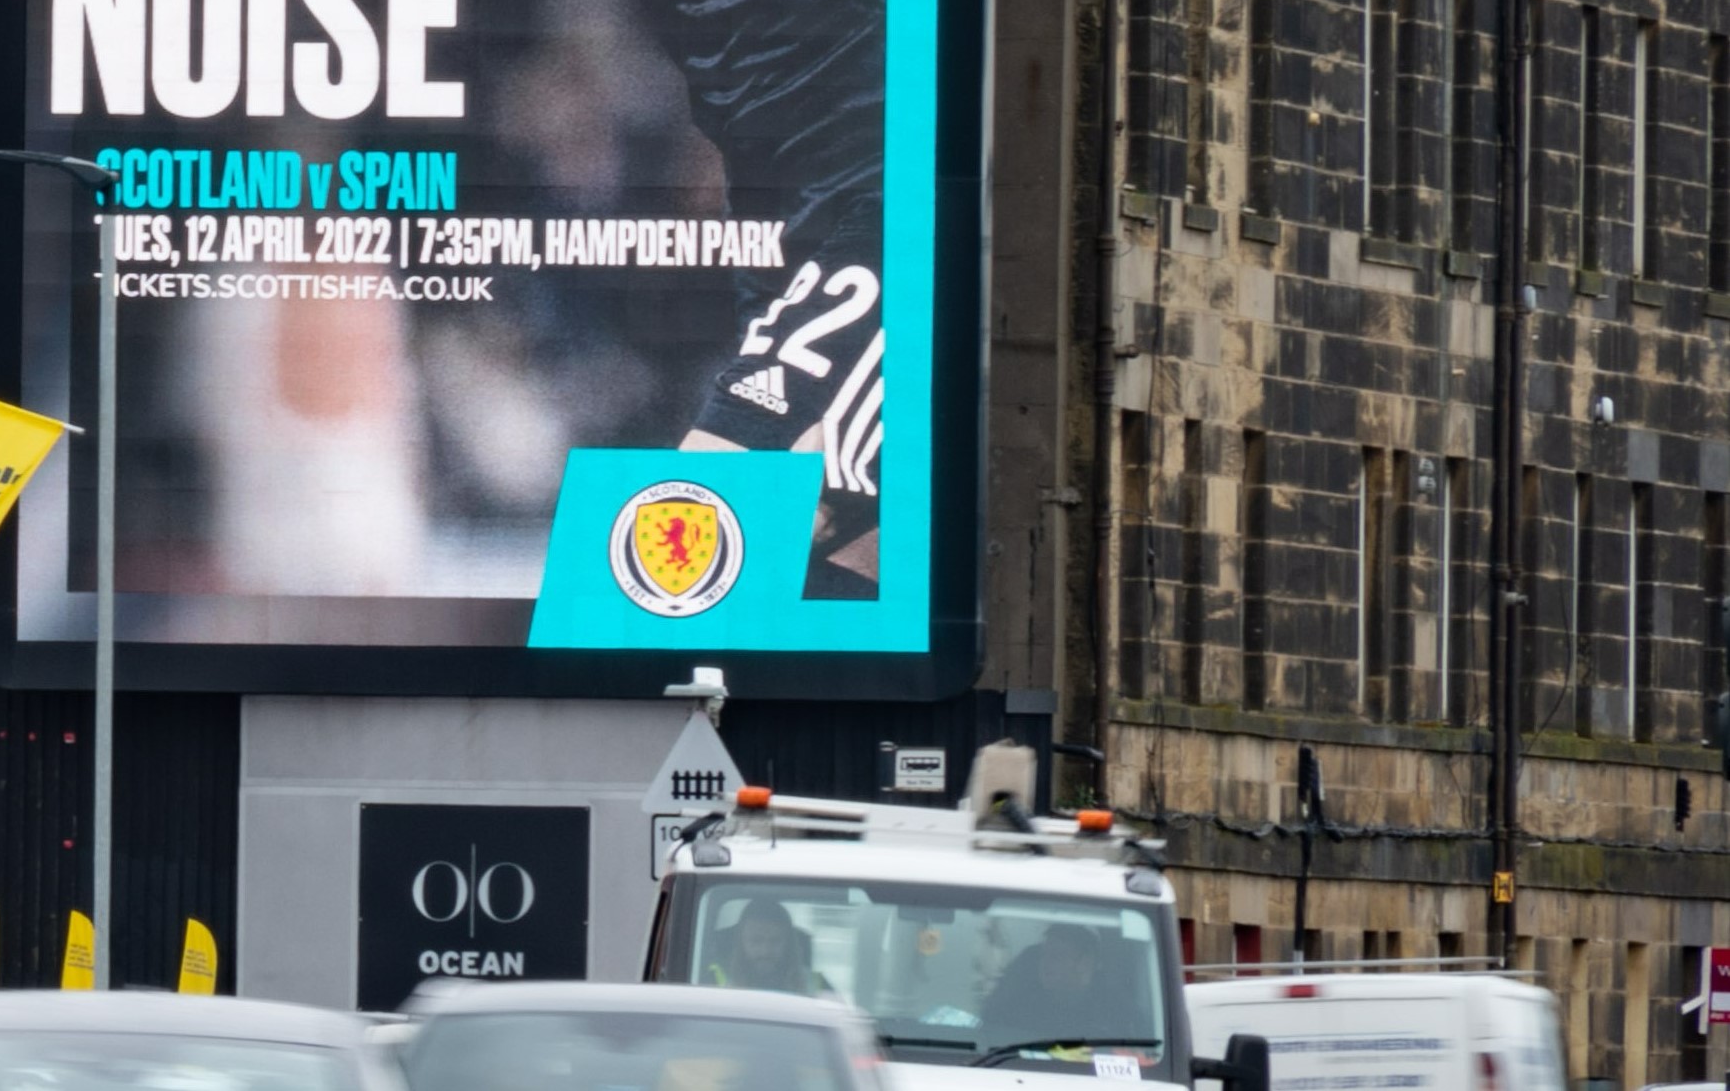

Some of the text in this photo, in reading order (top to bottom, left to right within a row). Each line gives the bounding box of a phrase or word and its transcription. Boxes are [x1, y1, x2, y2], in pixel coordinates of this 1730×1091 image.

[307, 163, 333, 210] v
[339, 151, 457, 211] SPAIN
[94, 215, 180, 268] UES,
[185, 215, 217, 262] 12
[221, 215, 311, 264] APRIL
[315, 216, 391, 264] 2022
[417, 218, 540, 271] 7:35PM,
[545, 219, 698, 268] HAMPDEN
[701, 220, 786, 268] PARK
[94, 272, 493, 302] ICKETS.SCOTTISHFA.CO.UK
[418, 949, 524, 976] OCEAN
